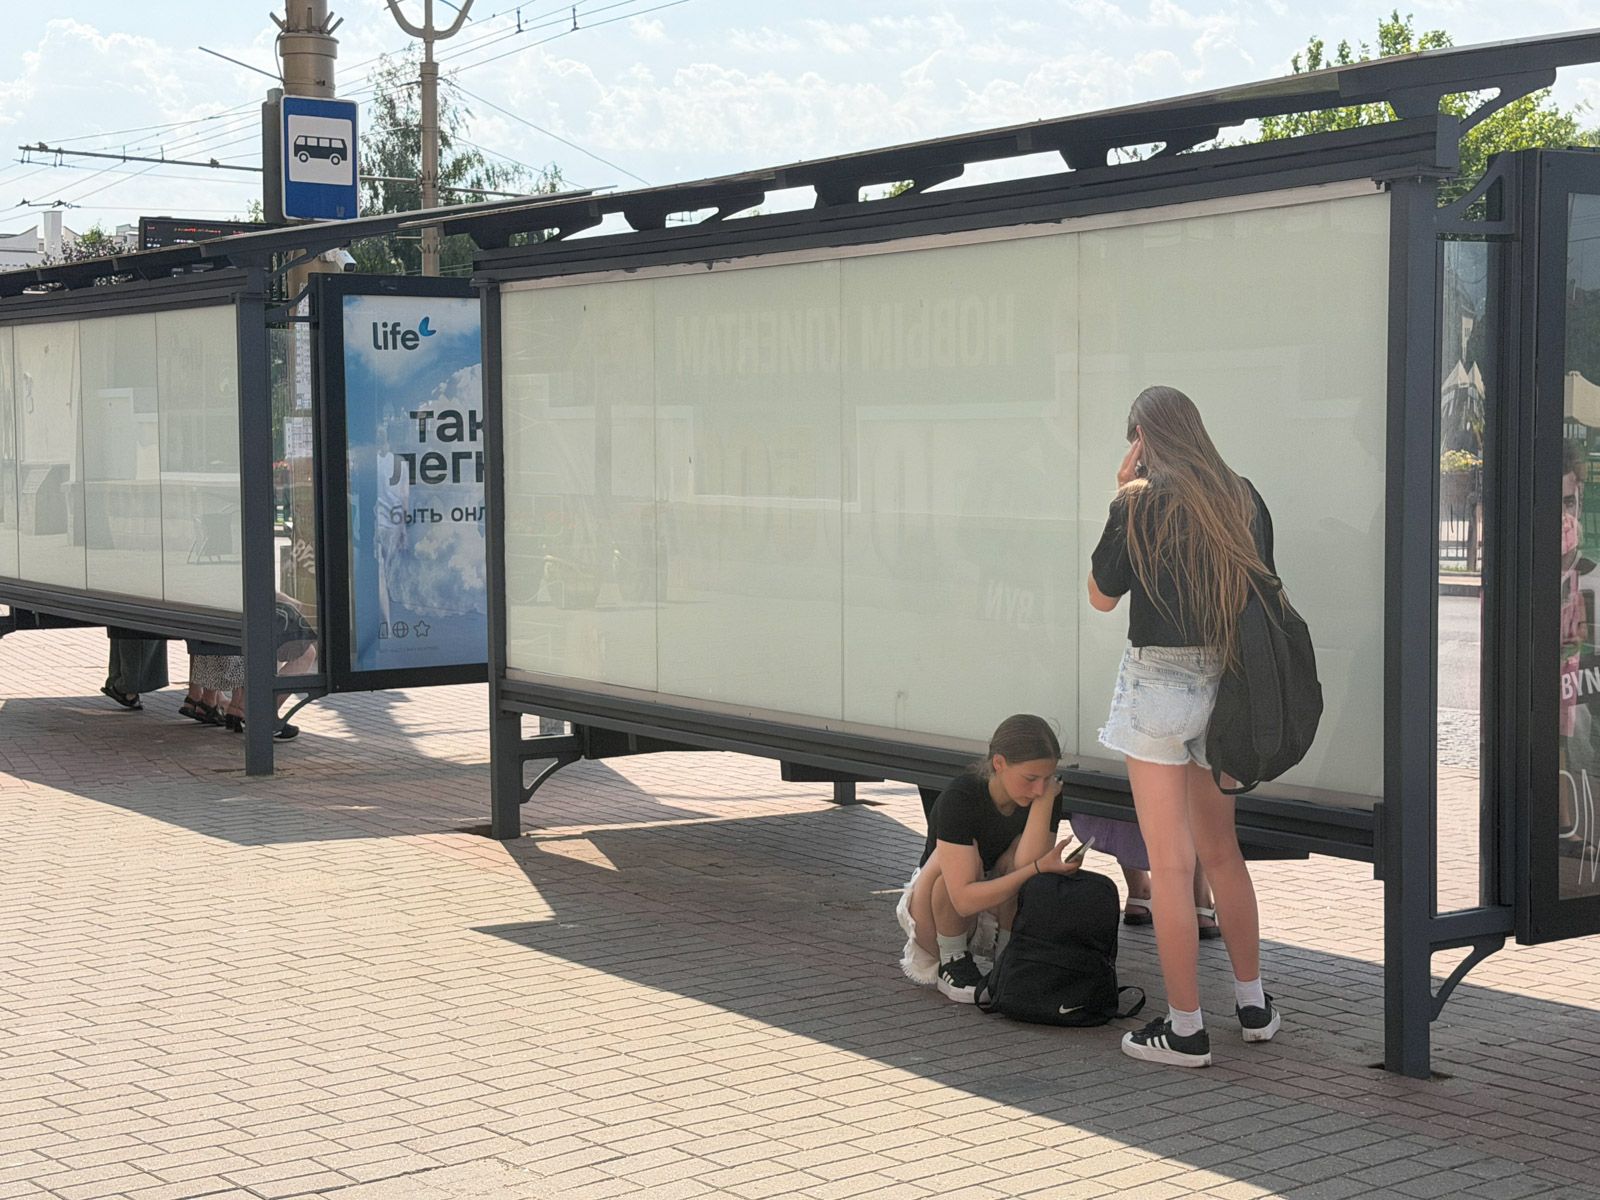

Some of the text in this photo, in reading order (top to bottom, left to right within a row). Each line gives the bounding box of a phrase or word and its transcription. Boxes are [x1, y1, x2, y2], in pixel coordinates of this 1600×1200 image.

[372, 321, 420, 351] life
[389, 504, 443, 526] быть
[1561, 666, 1600, 700] BYN
